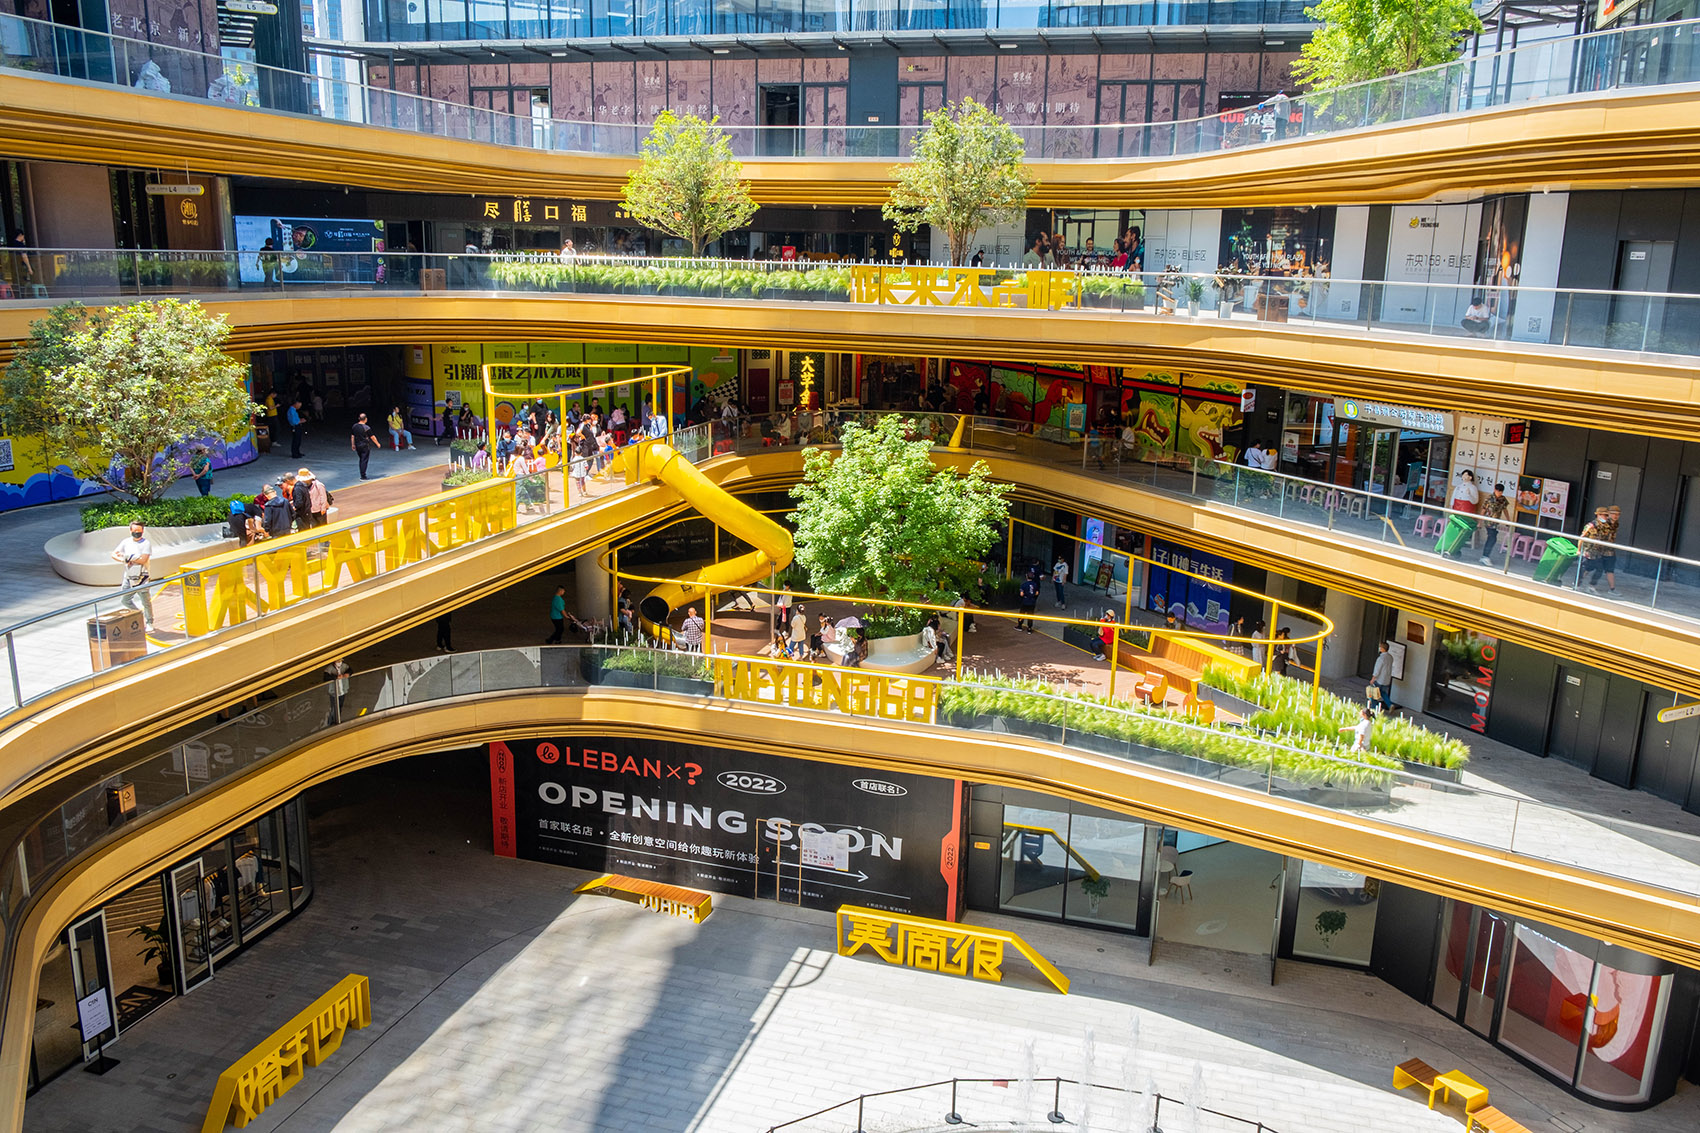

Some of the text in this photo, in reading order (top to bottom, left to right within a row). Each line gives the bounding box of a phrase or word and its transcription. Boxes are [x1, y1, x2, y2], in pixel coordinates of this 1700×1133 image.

[725, 773, 778, 792] 2022
[538, 781, 748, 834] OPENING
[538, 818, 594, 837] 首家联名店
[946, 847, 955, 867] 2022
